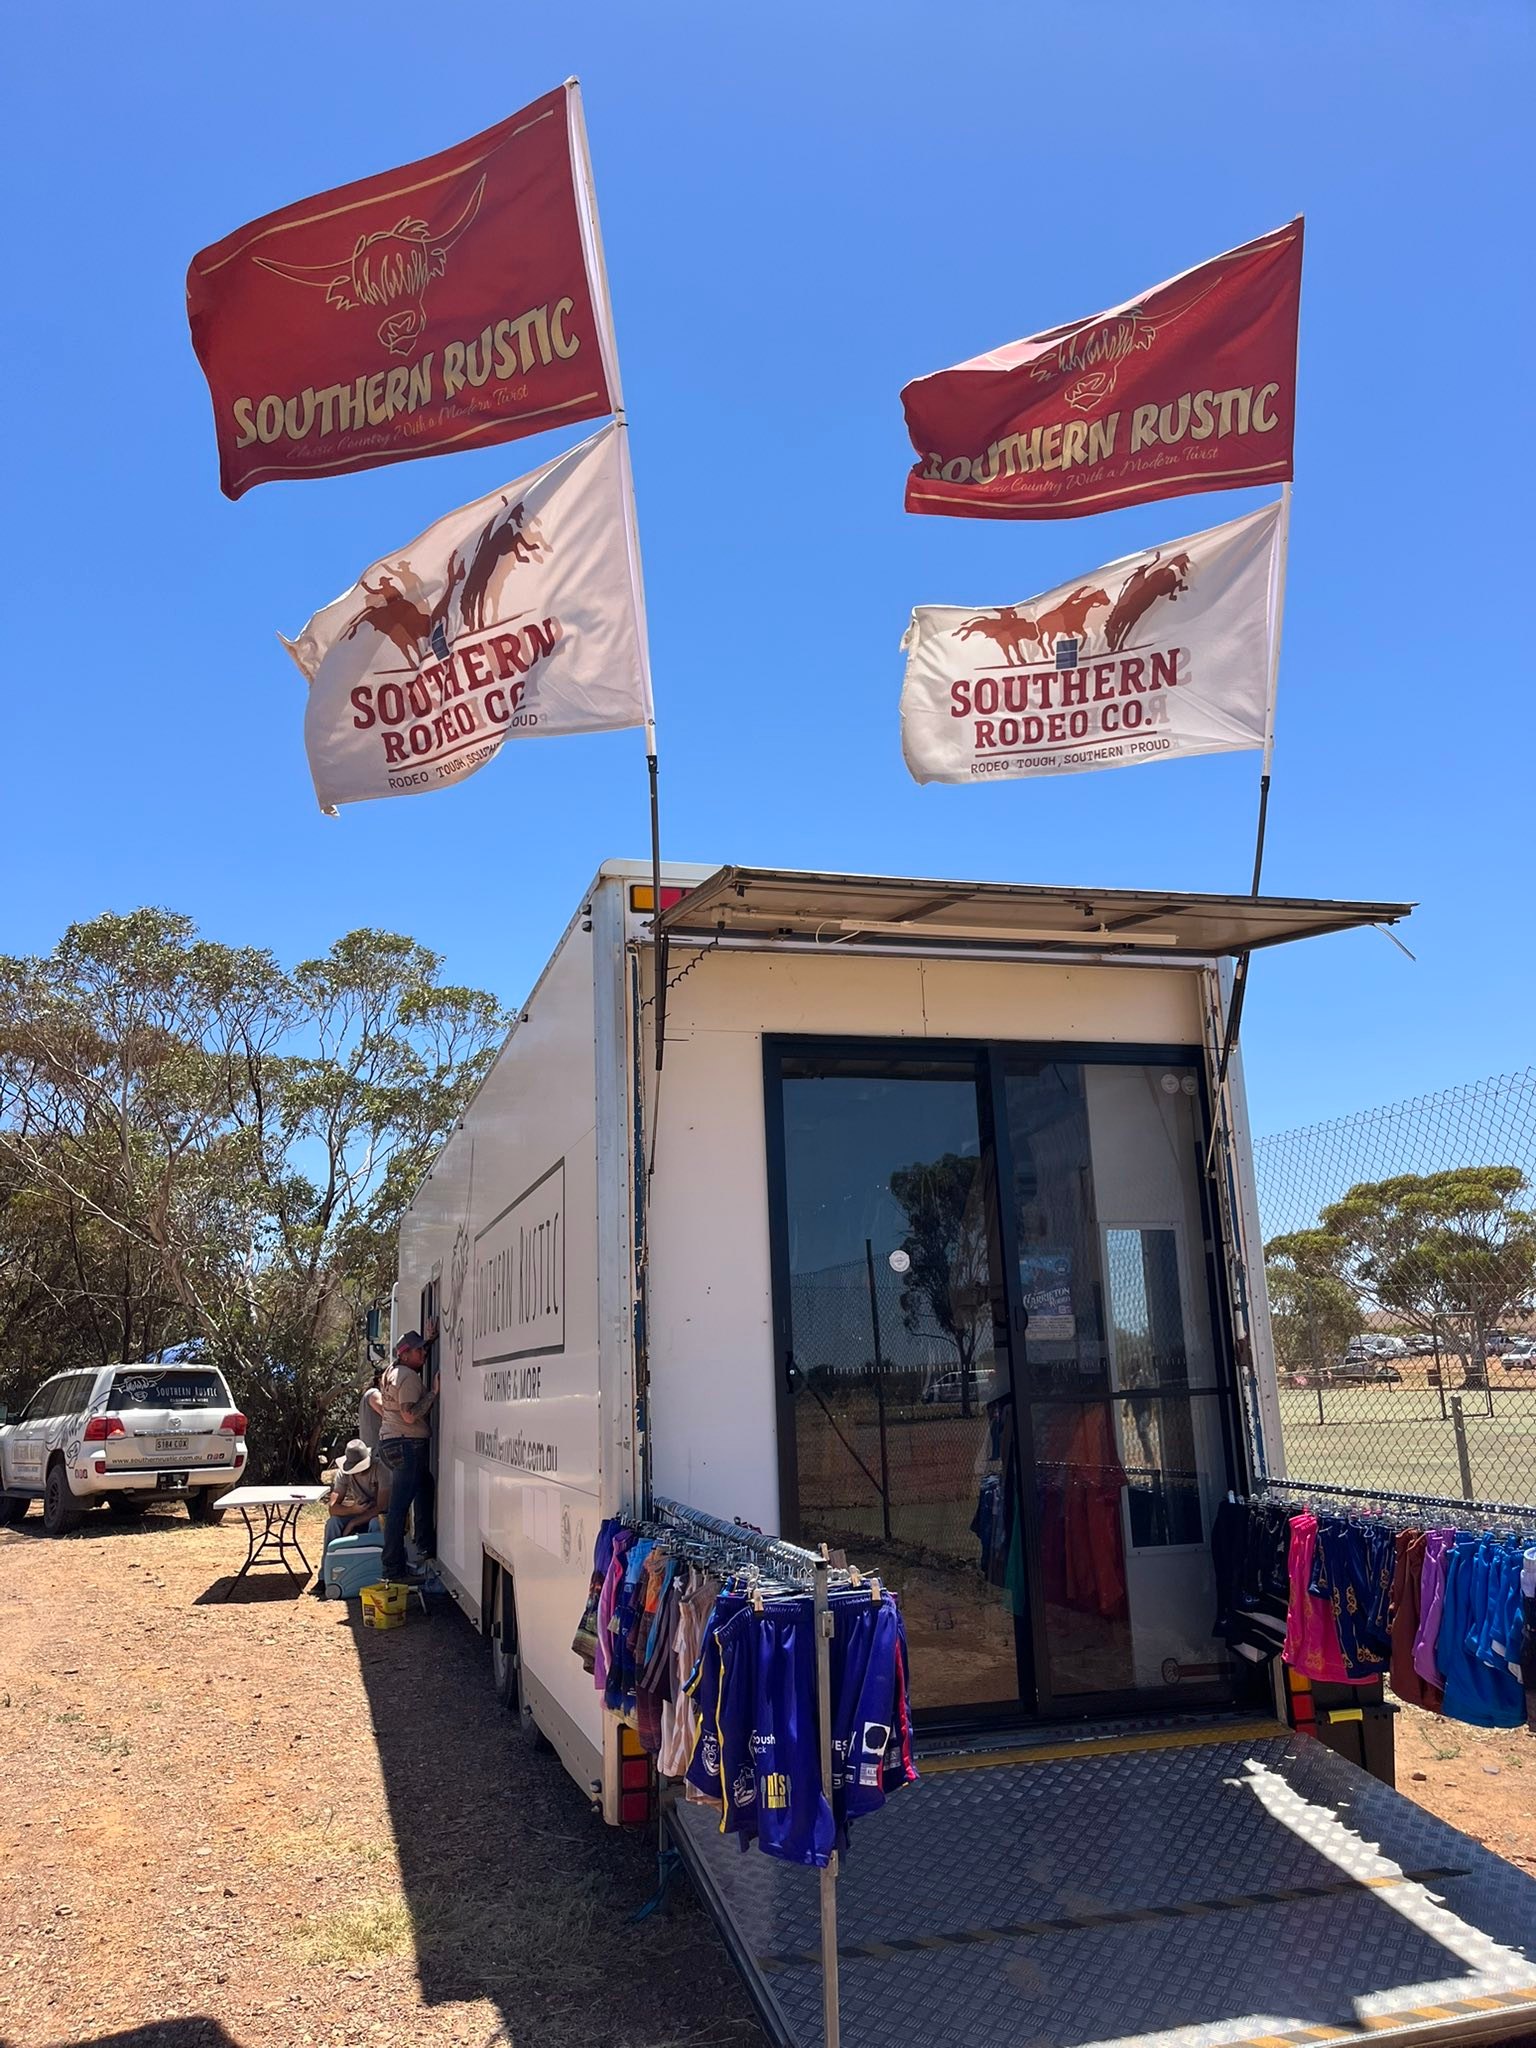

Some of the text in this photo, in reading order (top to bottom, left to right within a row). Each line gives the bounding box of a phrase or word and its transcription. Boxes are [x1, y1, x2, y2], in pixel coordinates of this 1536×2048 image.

[232, 296, 581, 449] SOUTHERN RUSTIC
[394, 421, 426, 441] With
[428, 418, 435, 429] a
[493, 384, 529, 408] Twist
[1130, 382, 1281, 455] RUSTIC
[1010, 477, 1062, 497] Country
[1066, 469, 1104, 490] With
[1107, 469, 1117, 478] a
[1120, 450, 1180, 477] Modern
[1183, 444, 1219, 462] Twist
[950, 648, 1181, 718] SOUTHERN
[974, 699, 1153, 750] RODEO CO.
[388, 771, 429, 790] RODEO
[970, 760, 1010, 774] RODEO
[1130, 738, 1171, 755] PROUD
[518, 1212, 559, 1325] RUSTIC
[156, 1386, 191, 1398] SOUTHERN
[520, 1366, 541, 1399] MORE
